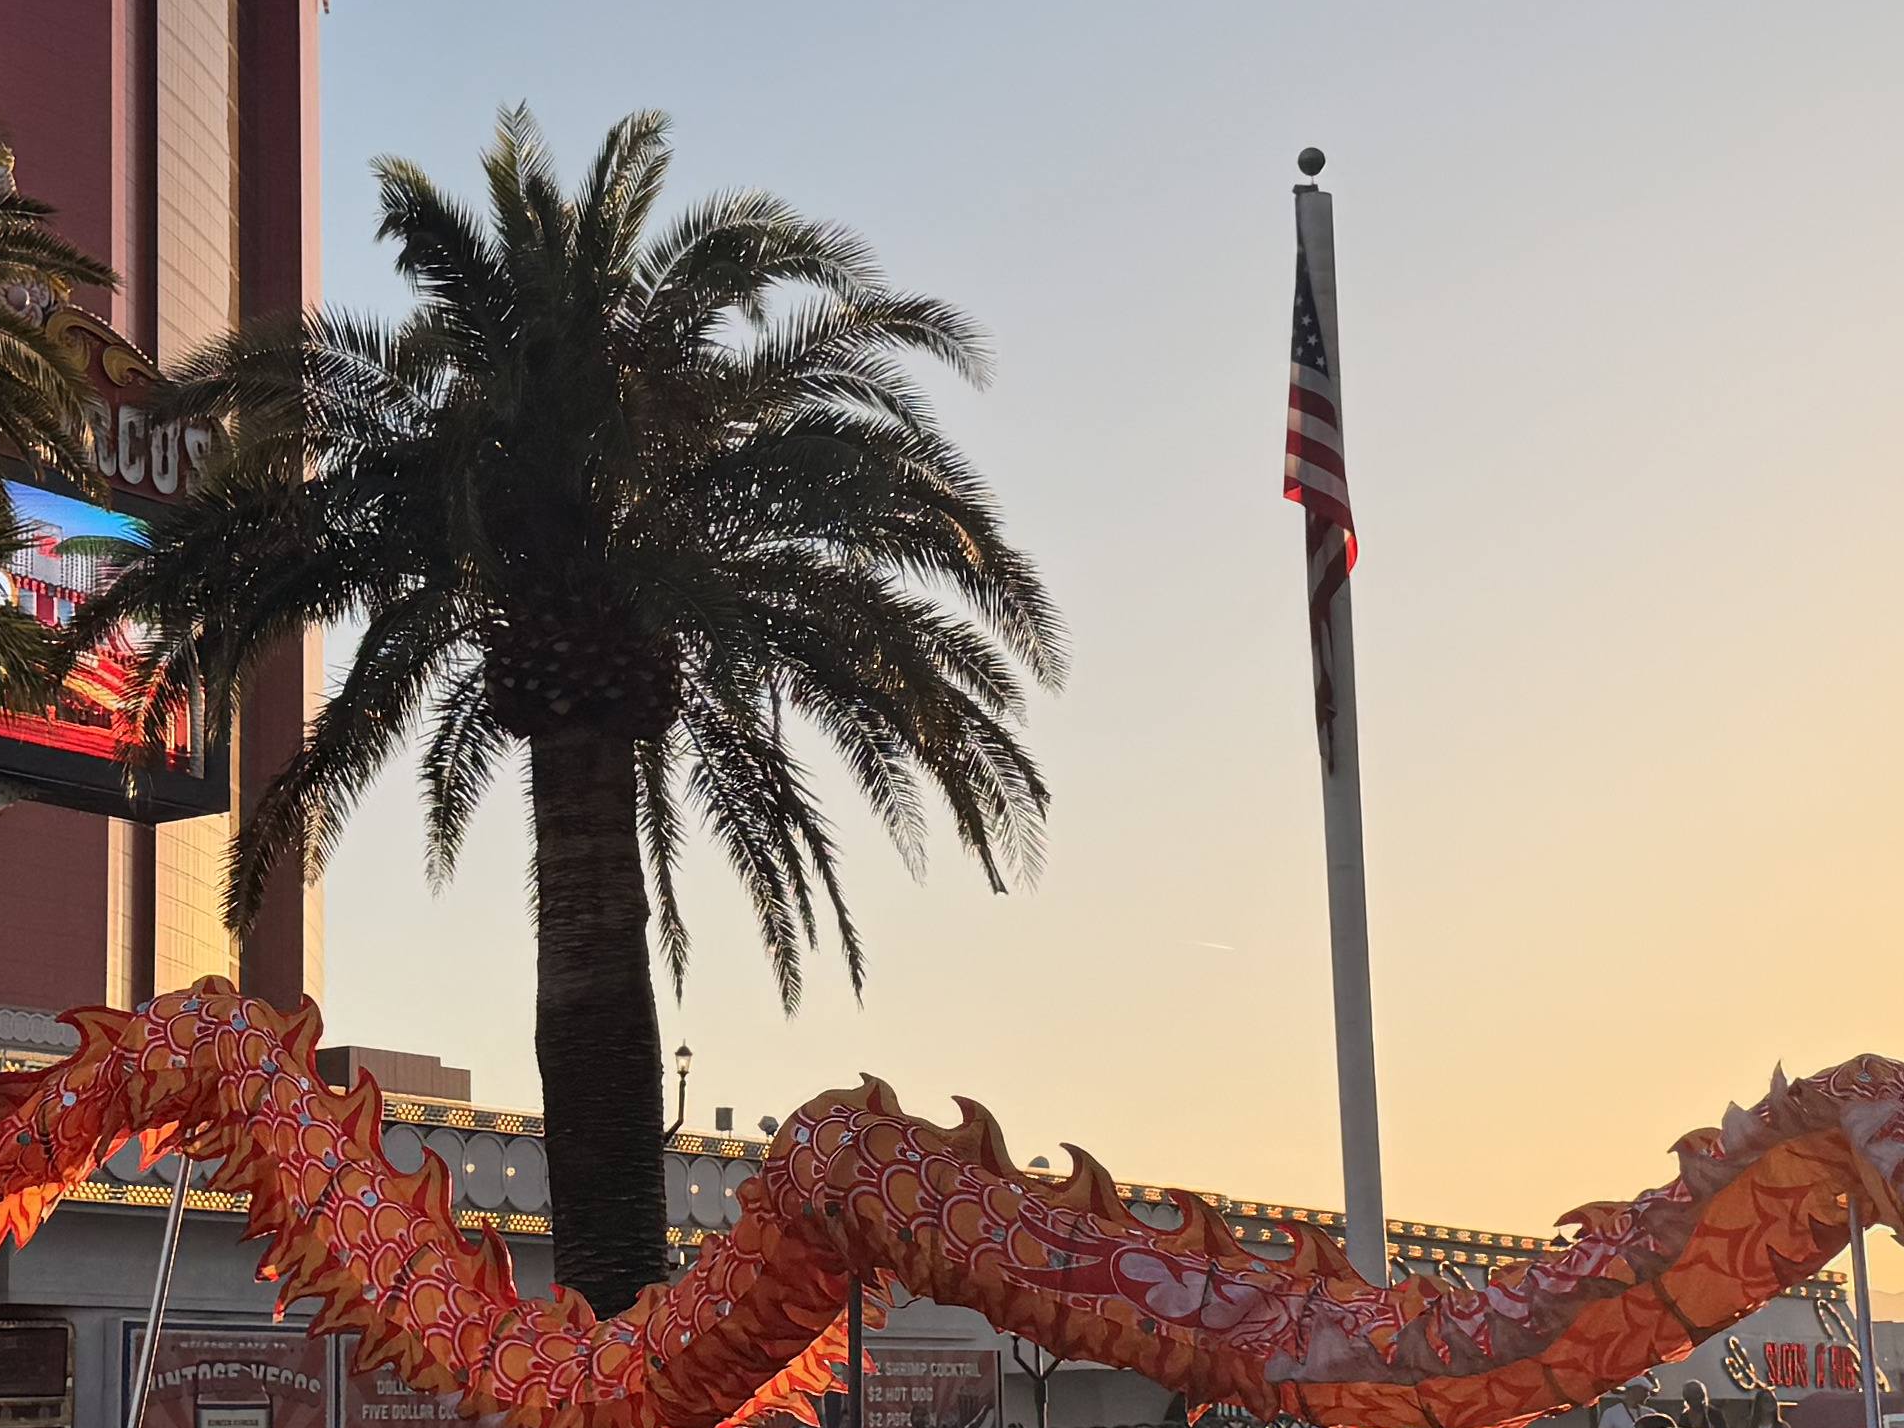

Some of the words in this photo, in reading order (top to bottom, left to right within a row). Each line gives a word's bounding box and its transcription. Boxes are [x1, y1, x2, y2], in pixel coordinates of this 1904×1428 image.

[867, 1386, 883, 1403] $2
[885, 1386, 908, 1402] HOT
[362, 1404, 388, 1420] FIVE
[391, 1404, 435, 1420] DOLLAR
[868, 1411, 884, 1428] $2
